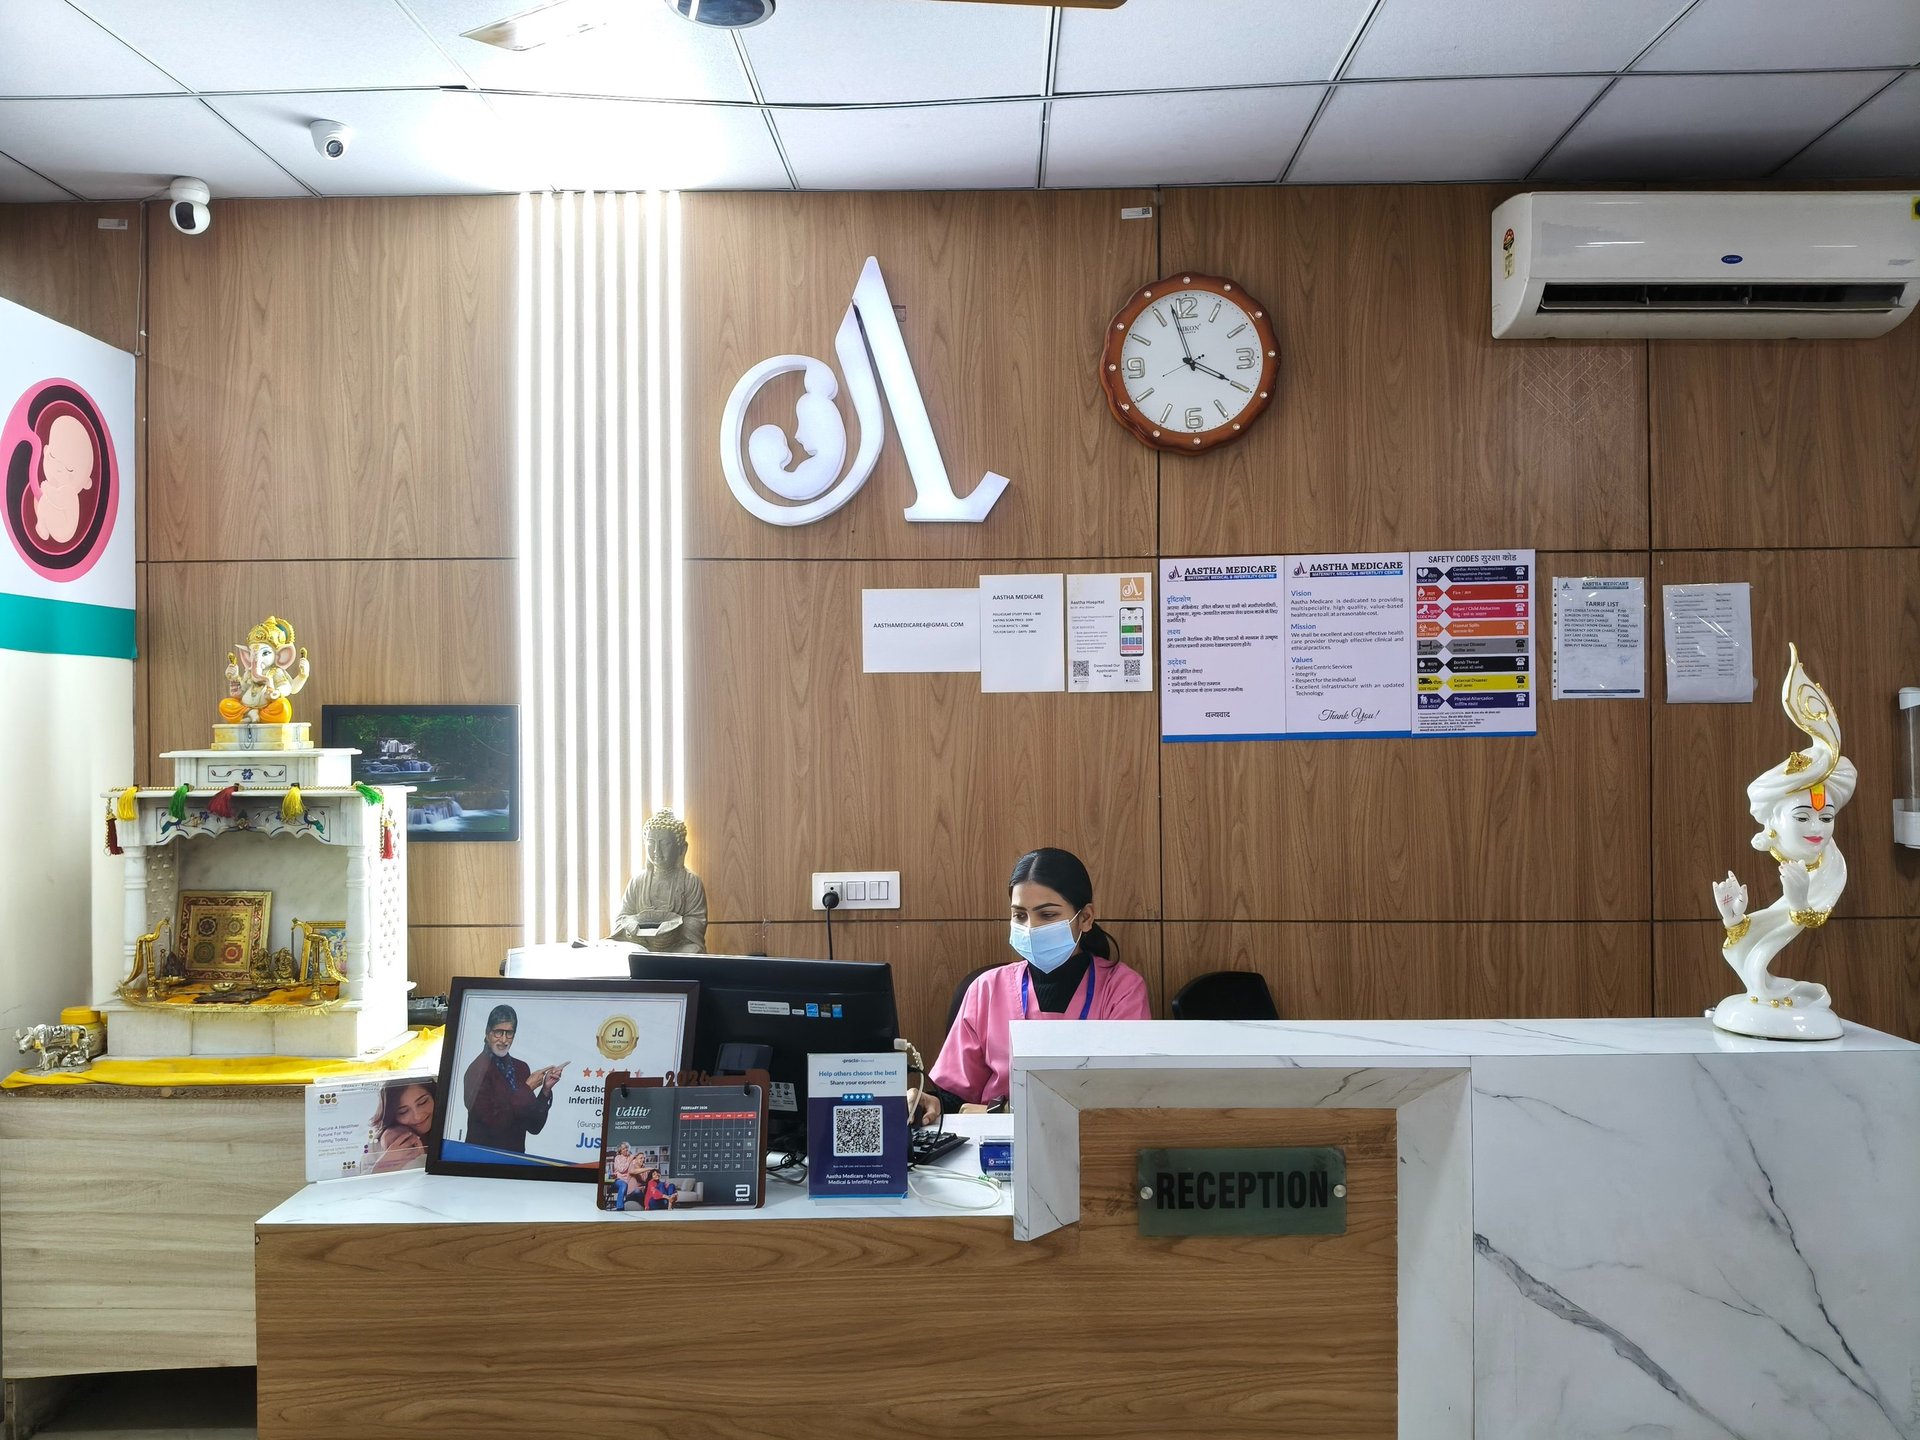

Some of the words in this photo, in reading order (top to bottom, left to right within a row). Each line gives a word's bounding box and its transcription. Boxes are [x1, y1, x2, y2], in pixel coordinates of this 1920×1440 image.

[1176, 297, 1198, 319] 12
[1236, 347, 1254, 369] 3
[1127, 357, 1145, 379] 9
[1185, 408, 1203, 429] 6
[1428, 555, 1454, 563] SAFETY
[1456, 554, 1479, 562] CODES
[1185, 567, 1223, 575] AASTHA
[1226, 565, 1277, 574] MEDICARE
[1309, 564, 1348, 572] AASTHA
[1351, 562, 1403, 570] MEDICARE
[1318, 709, 1349, 721] Thank
[1351, 707, 1380, 724] You!
[612, 1027, 625, 1038] Jd
[568, 1096, 603, 1105] Infertilit
[615, 1106, 651, 1117] Udiliv
[1156, 1171, 1328, 1209] RECEPTION
